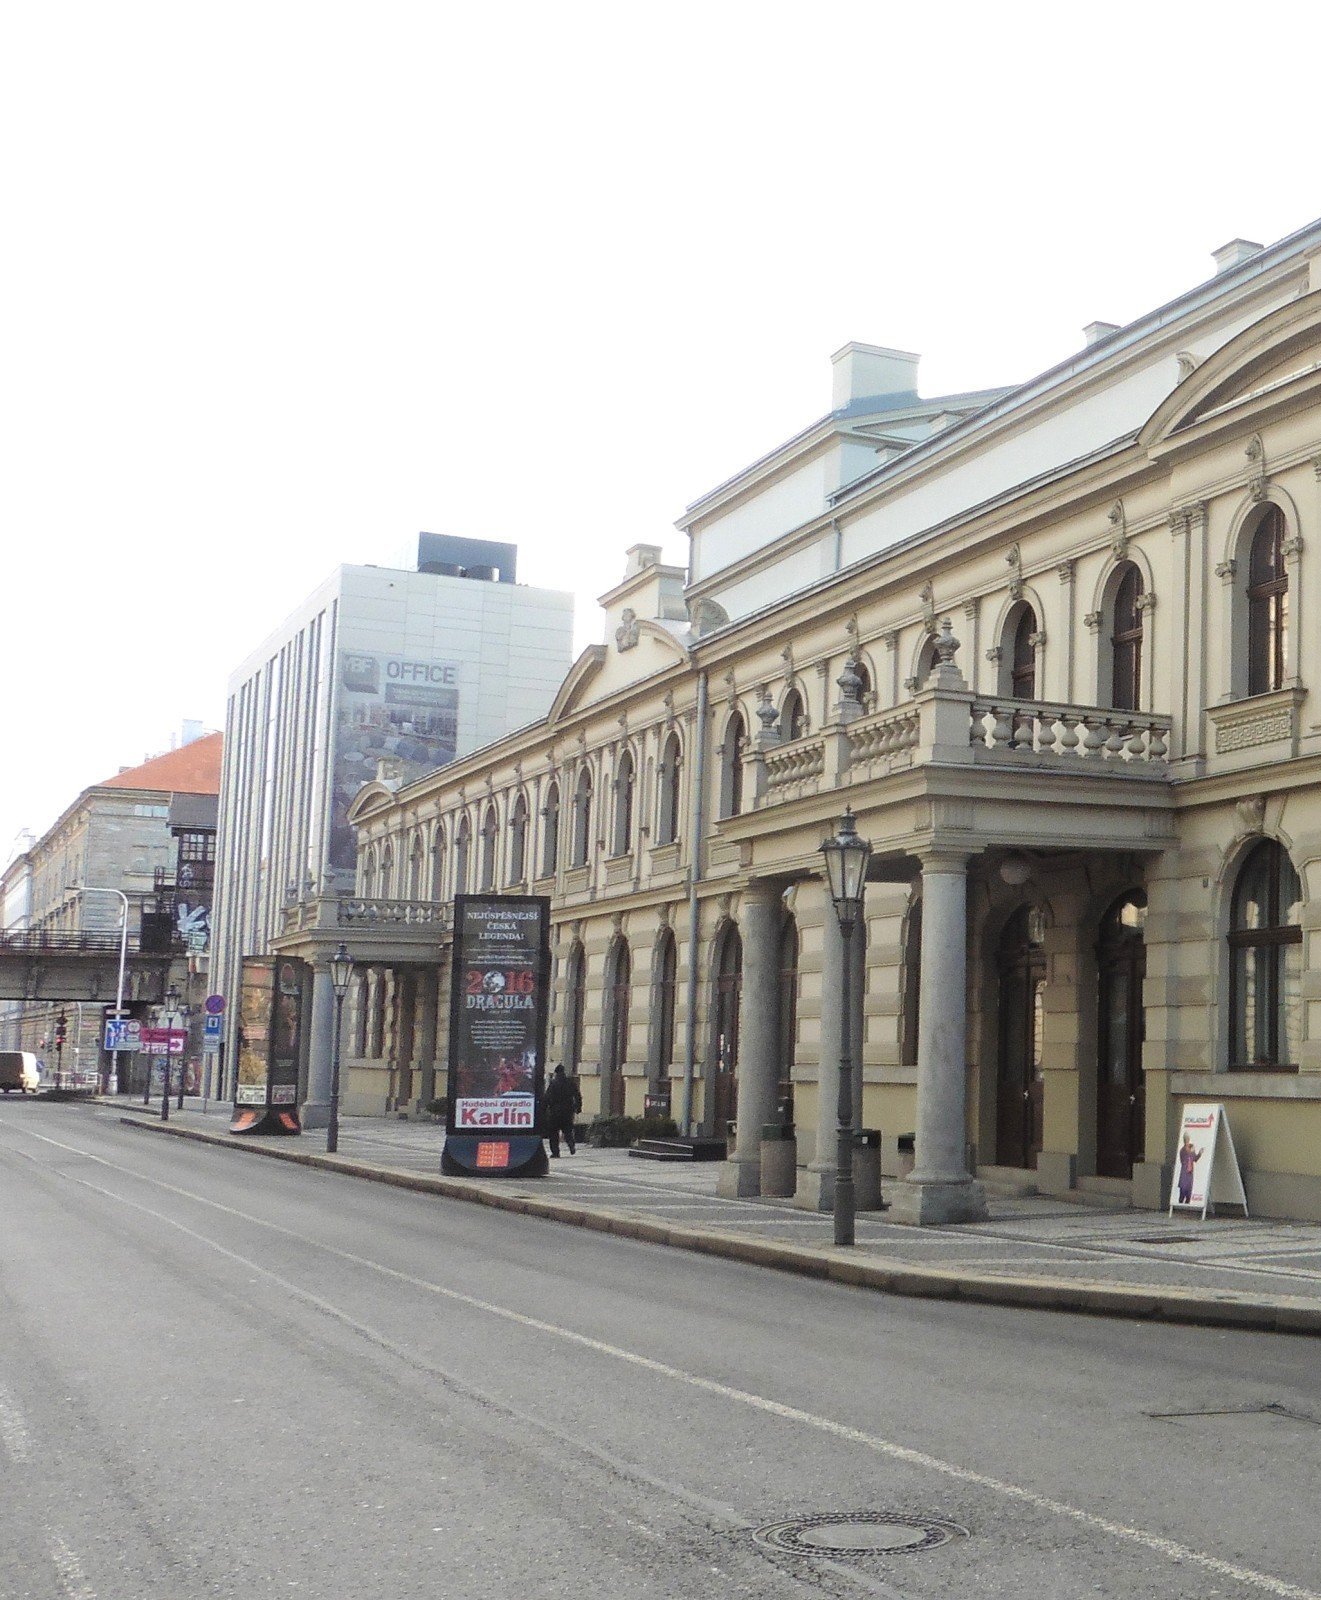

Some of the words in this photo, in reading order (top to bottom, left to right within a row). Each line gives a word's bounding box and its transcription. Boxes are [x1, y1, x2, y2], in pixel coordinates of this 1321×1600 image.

[386, 661, 456, 684] OFFICE
[465, 994, 535, 1011] DRACULA
[461, 1107, 531, 1126] Karlín
